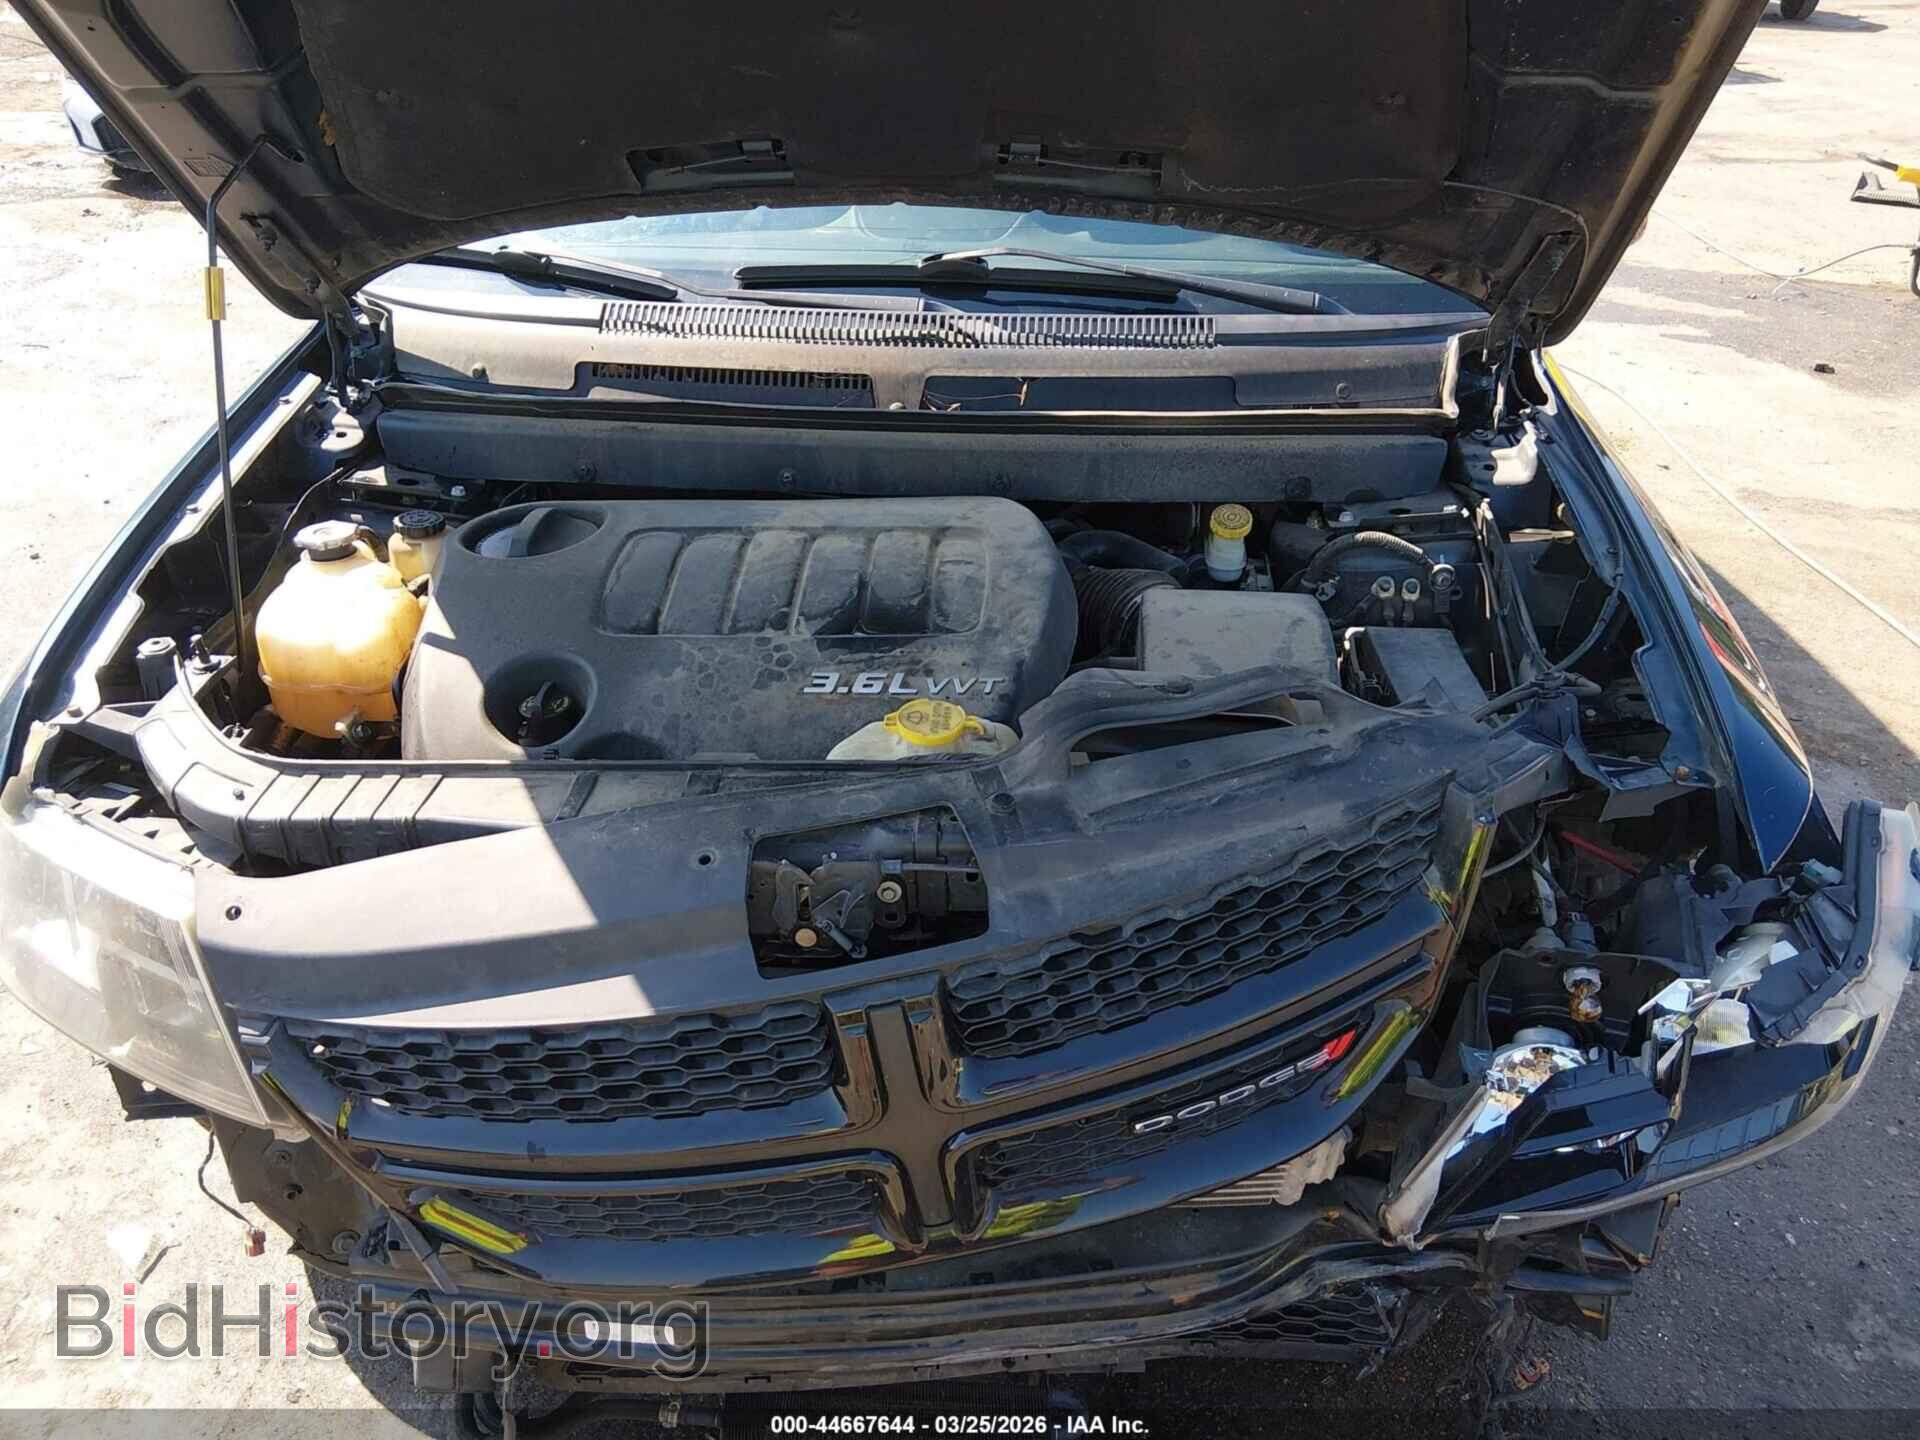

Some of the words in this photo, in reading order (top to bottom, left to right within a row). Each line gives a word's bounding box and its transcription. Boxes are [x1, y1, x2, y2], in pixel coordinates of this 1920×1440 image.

[803, 672, 918, 694] 3.6L
[926, 677, 1007, 694] VVT
[1134, 1048, 1330, 1134] DODGE
